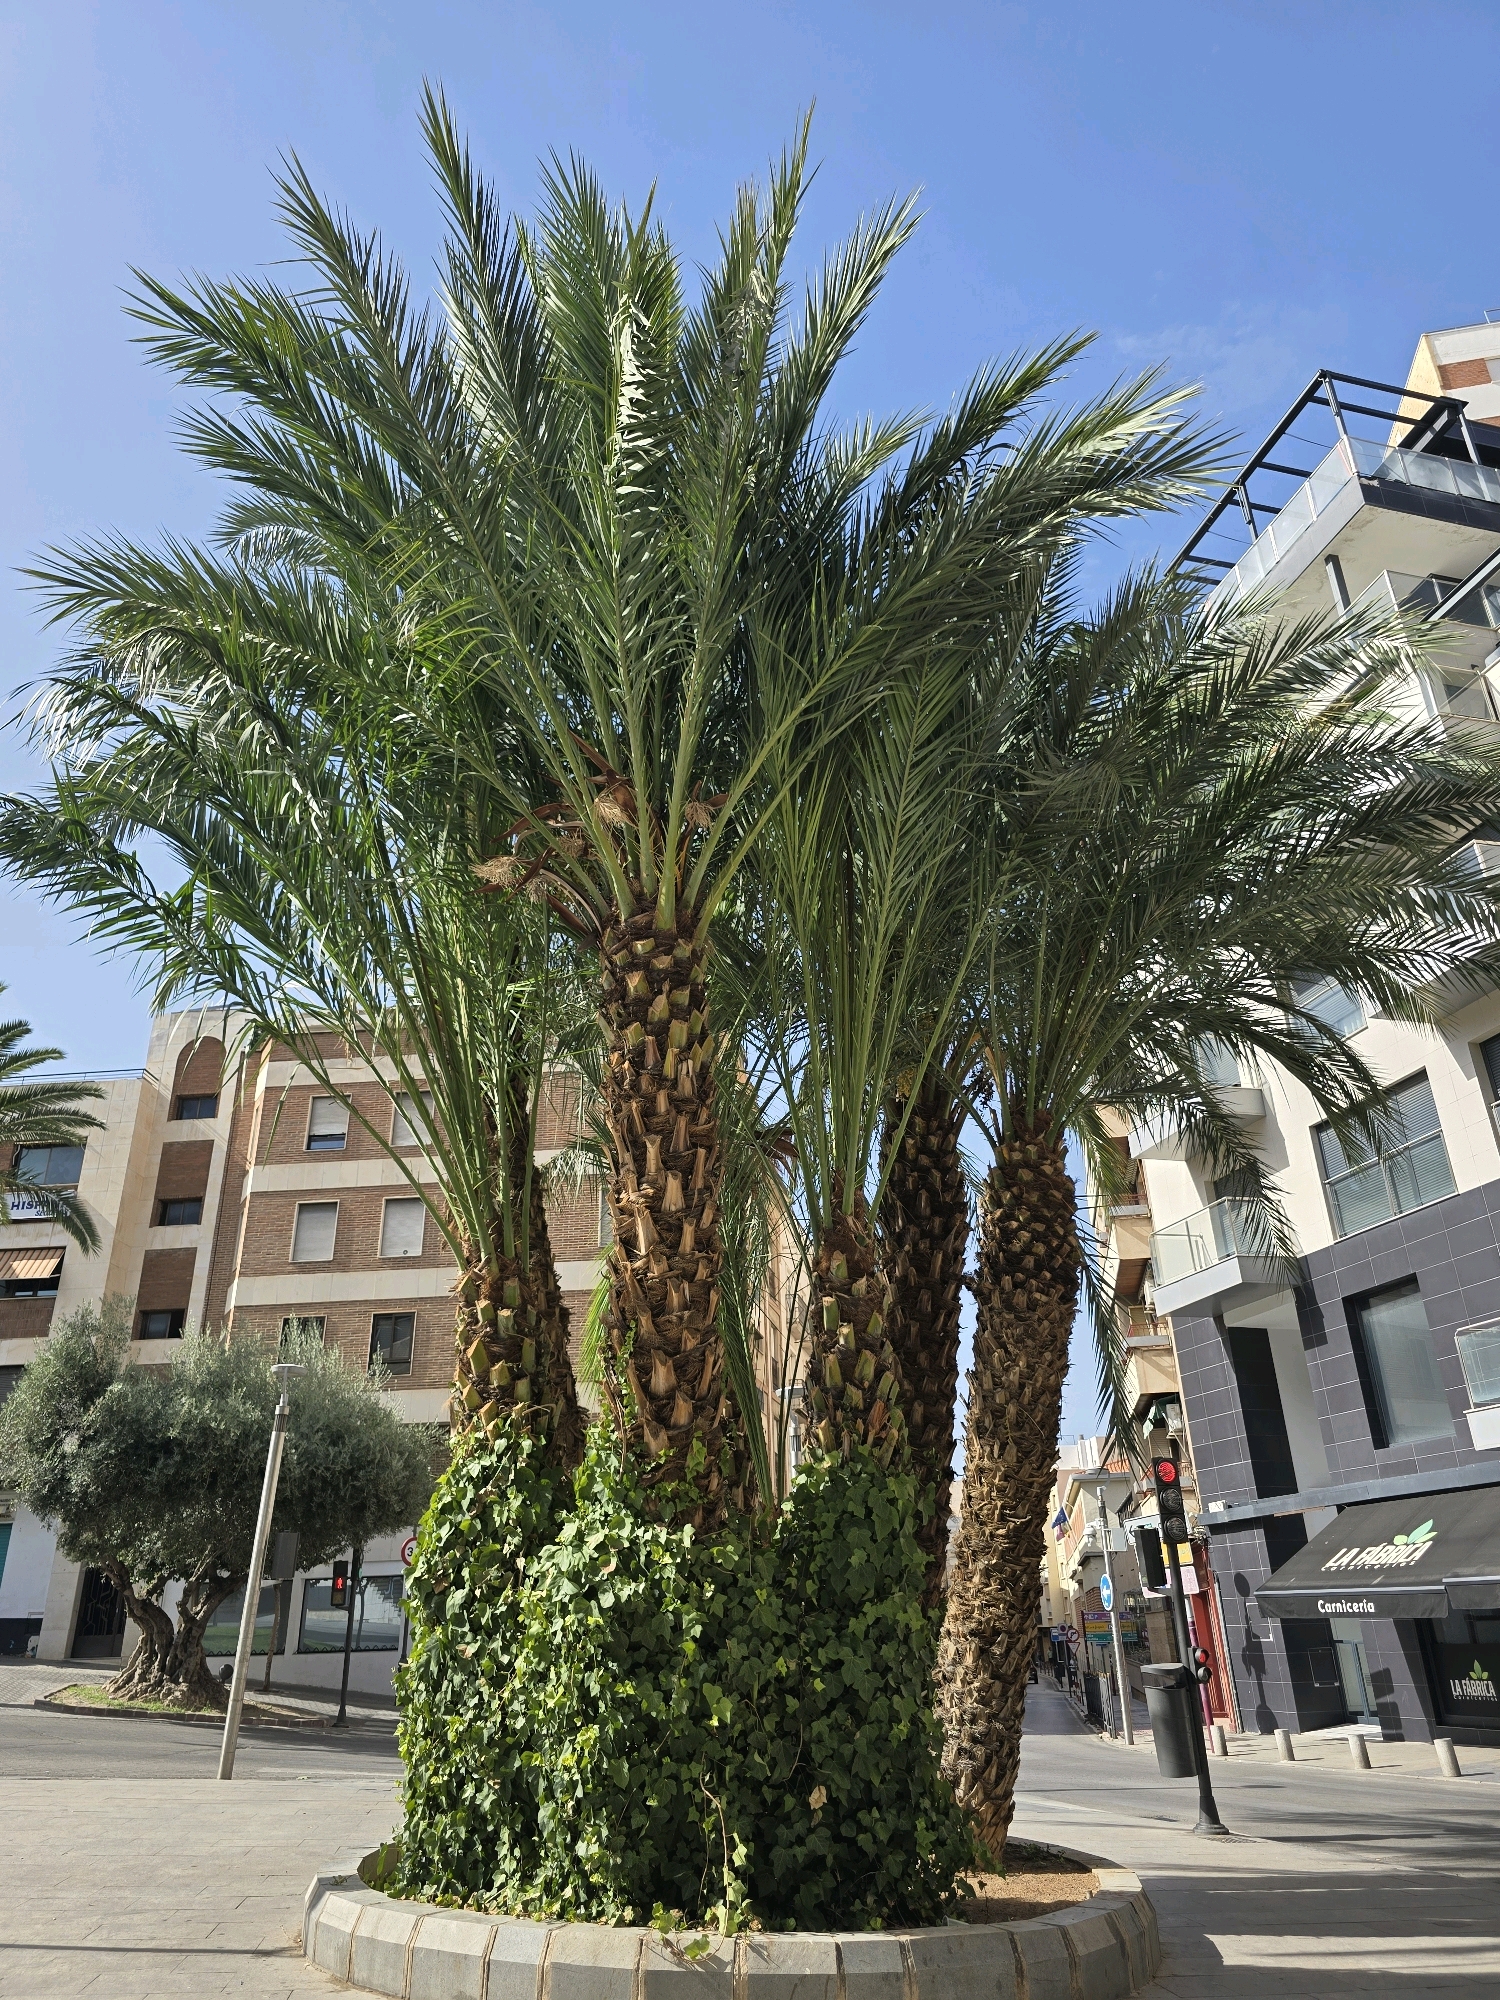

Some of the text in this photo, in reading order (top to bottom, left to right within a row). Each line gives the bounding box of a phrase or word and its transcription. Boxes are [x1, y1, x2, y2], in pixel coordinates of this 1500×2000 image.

[1326, 1541, 1433, 1567] LA FÁBRICA
[1450, 1676, 1497, 1697] LA FÁBRICA
